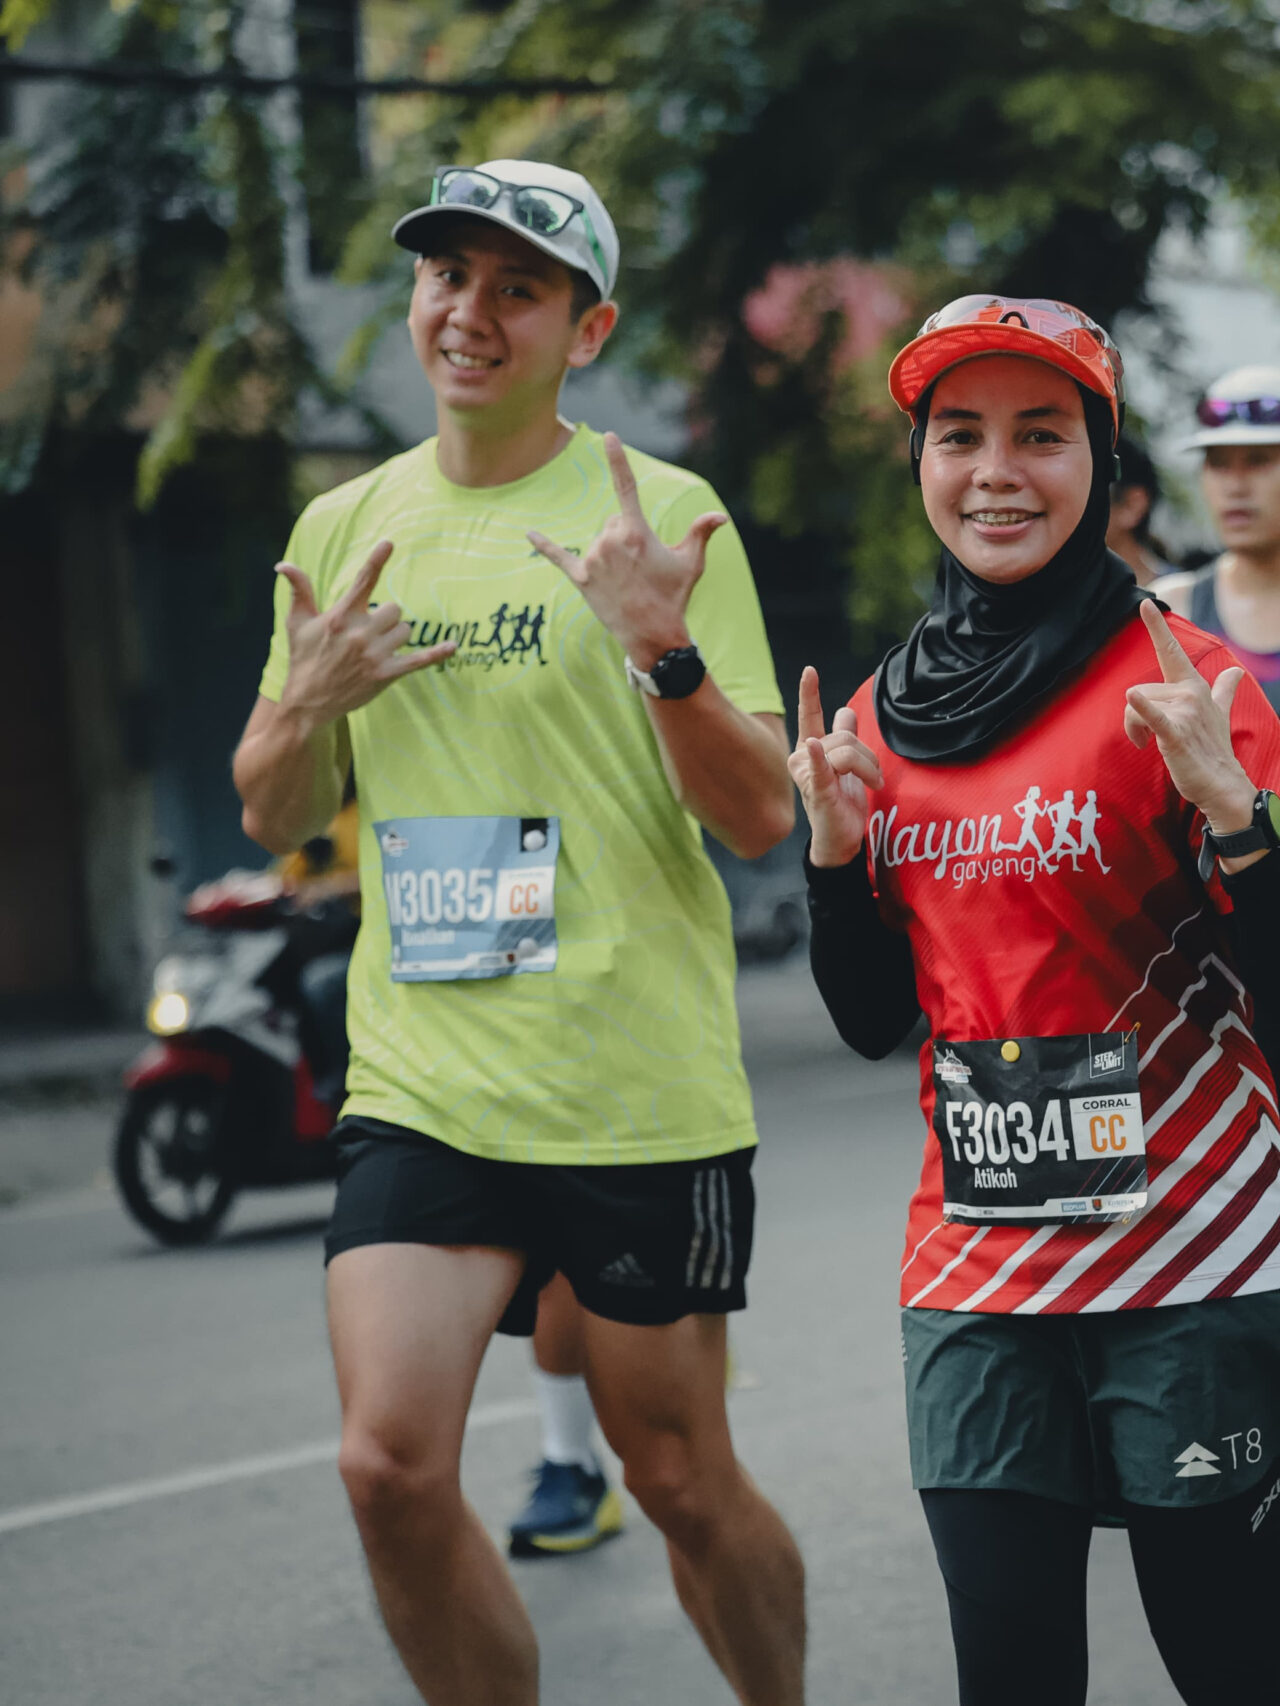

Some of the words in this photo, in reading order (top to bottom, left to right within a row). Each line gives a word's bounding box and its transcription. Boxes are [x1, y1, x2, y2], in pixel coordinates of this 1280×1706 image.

[869, 804, 1002, 889] Playon
[952, 856, 1036, 890] gayeng
[509, 883, 539, 915] CC
[1082, 1097, 1131, 1110] CORRAL
[946, 1099, 1070, 1165] F3034
[1089, 1114, 1127, 1152] CC
[974, 1167, 1018, 1189] Atikoh
[1221, 1427, 1262, 1470] T8
